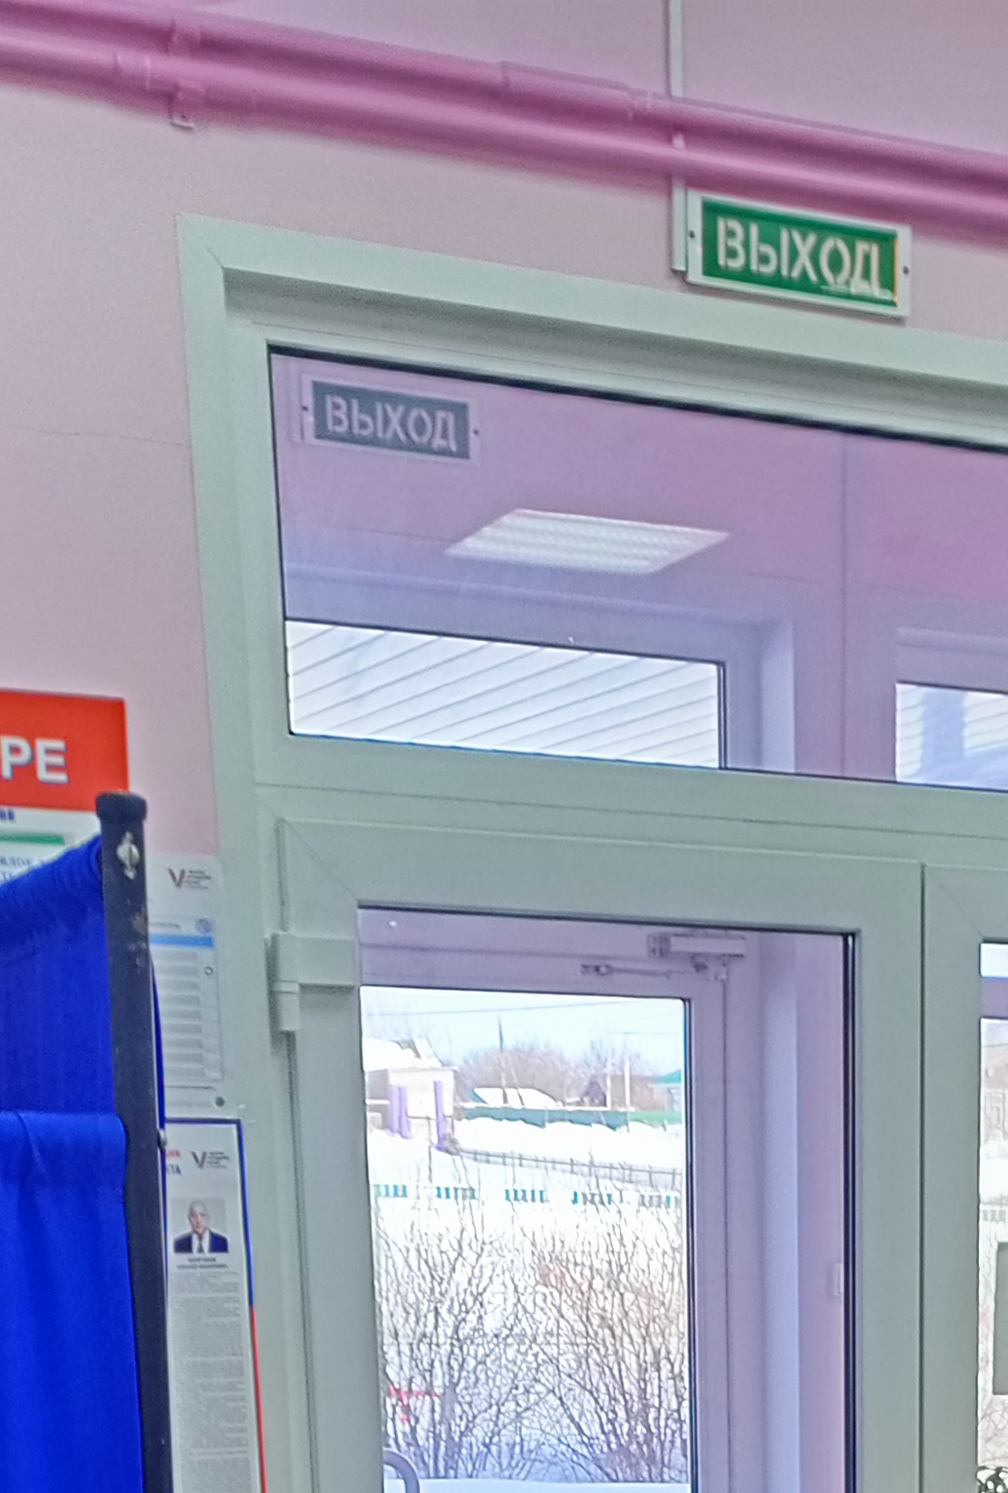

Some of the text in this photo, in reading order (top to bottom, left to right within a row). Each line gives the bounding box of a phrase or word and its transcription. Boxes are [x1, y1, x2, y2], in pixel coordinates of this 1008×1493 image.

[716, 216, 885, 298] ВЫХОД
[325, 396, 460, 453] ВЫХОД
[0, 735, 69, 785] РЕ
